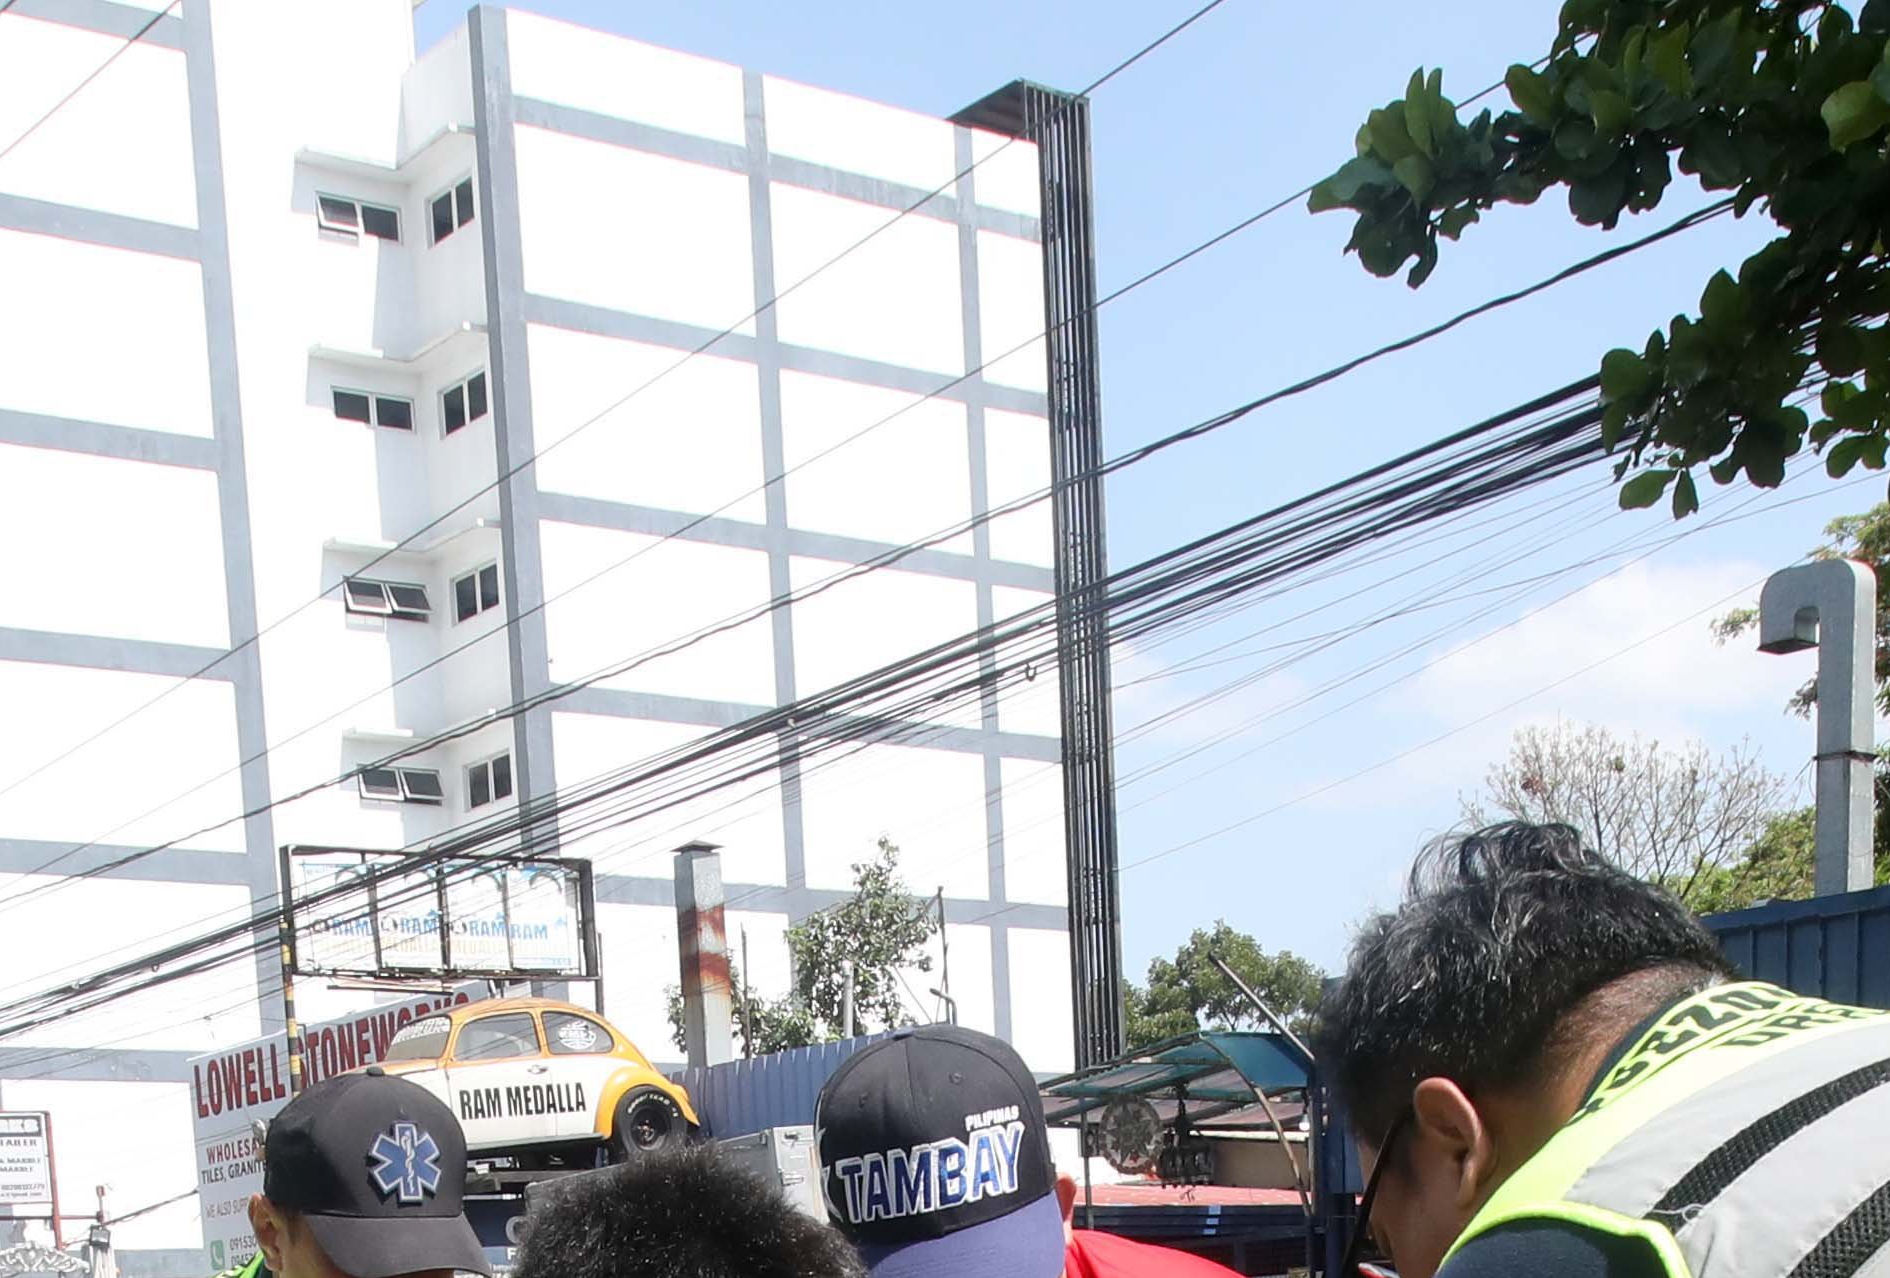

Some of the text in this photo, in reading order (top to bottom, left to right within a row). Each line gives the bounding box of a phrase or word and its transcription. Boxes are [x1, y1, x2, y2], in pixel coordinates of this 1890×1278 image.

[469, 919, 506, 937] RAM
[510, 922, 549, 940] RAM
[193, 1043, 287, 1119] LOWELL
[459, 1087, 504, 1121] RAM
[506, 1082, 587, 1118] MEDALLA
[964, 1105, 1020, 1132] PILIPINAS
[206, 1136, 261, 1165] WHOLESA
[201, 1166, 227, 1185] TILES,
[835, 1121, 1026, 1225] TAMBAY
